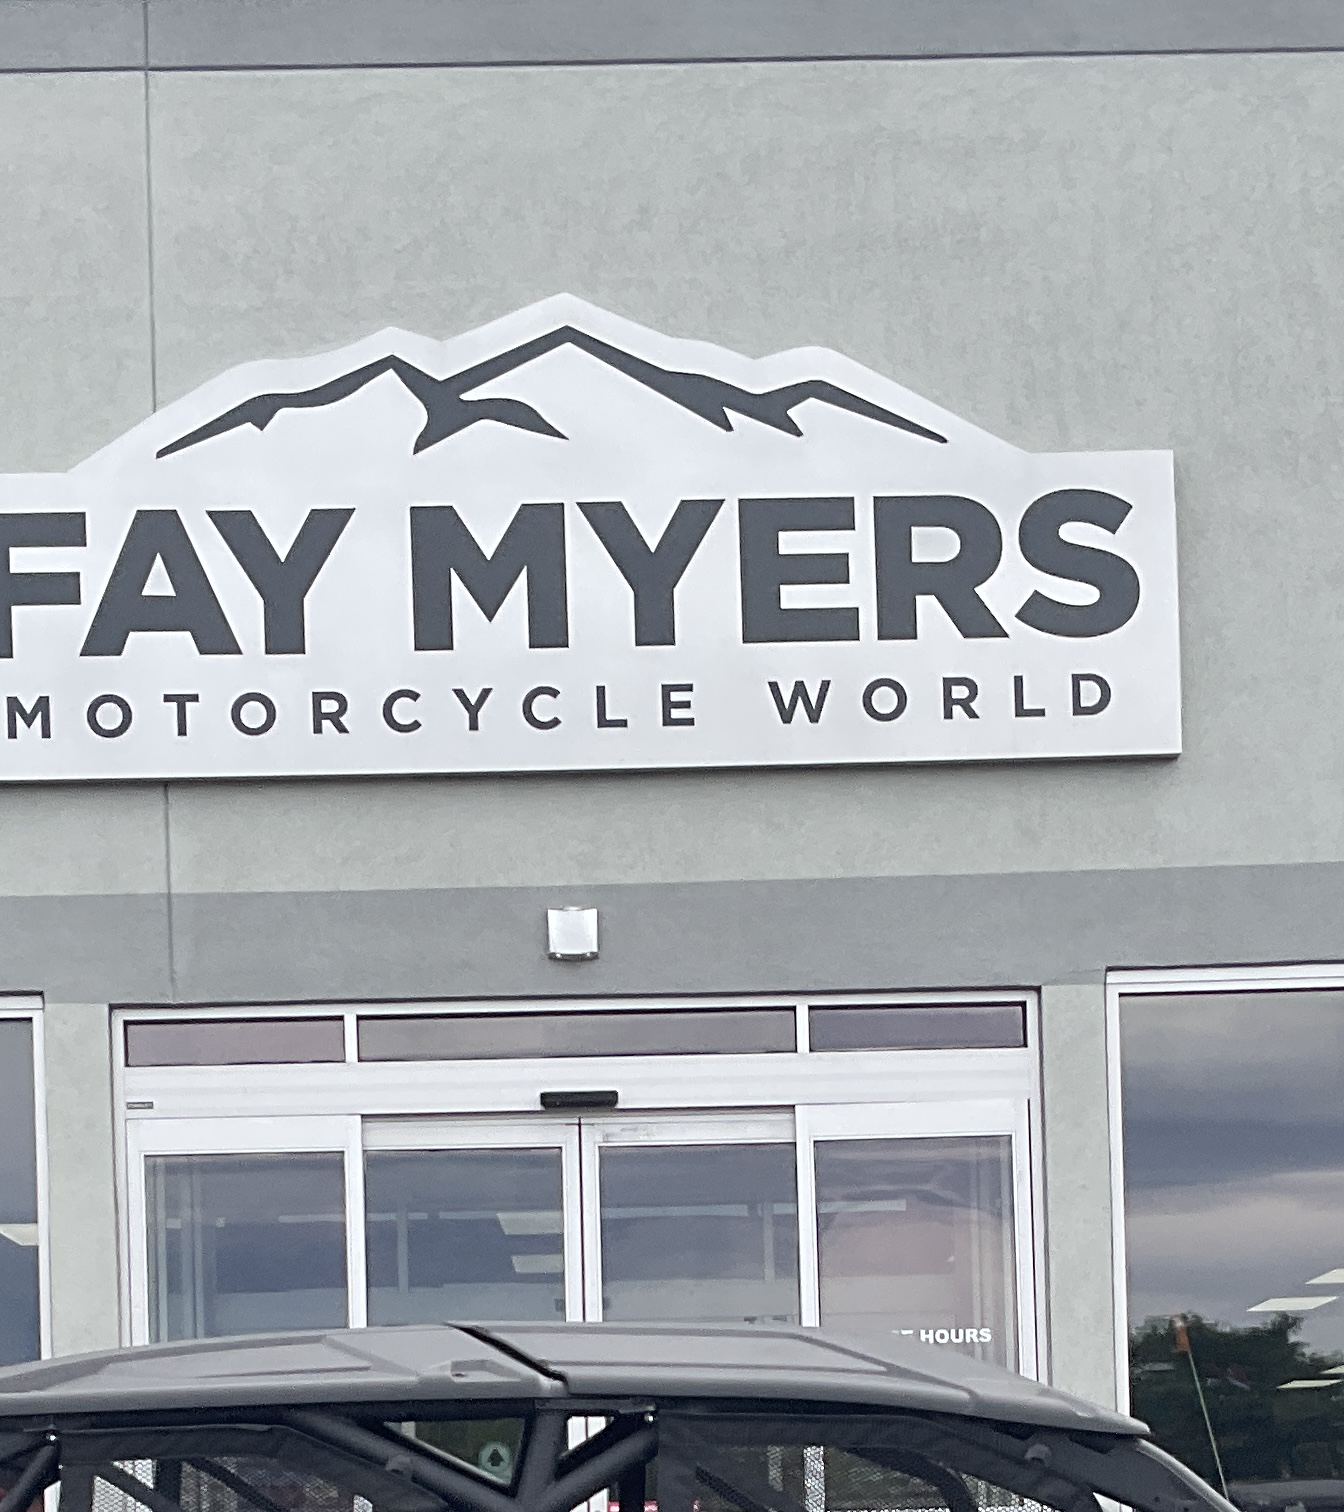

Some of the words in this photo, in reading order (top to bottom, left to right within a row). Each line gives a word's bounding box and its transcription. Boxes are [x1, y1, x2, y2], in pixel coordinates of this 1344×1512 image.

[409, 489, 1142, 652] MYERS
[6, 683, 696, 740] MOTORCYCLE
[767, 672, 1113, 725] WORLD
[920, 1328, 992, 1344] HOURS
